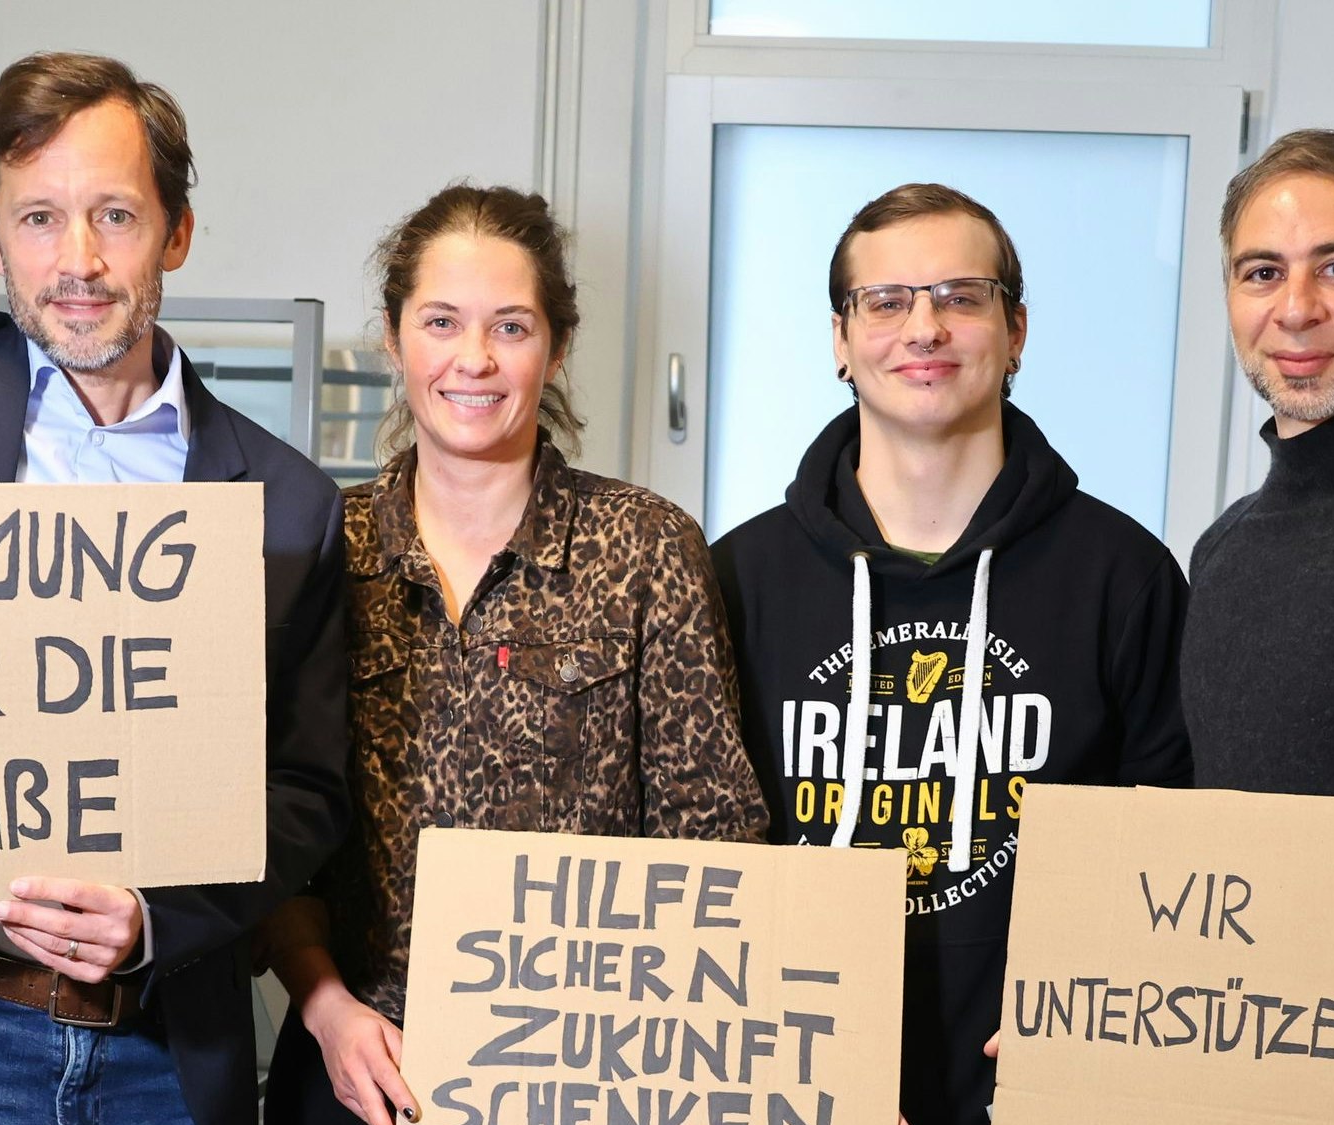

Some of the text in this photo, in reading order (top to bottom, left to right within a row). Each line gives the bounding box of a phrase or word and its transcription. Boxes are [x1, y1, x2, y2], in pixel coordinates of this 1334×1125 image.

[35, 635, 178, 713] DIE
[809, 642, 854, 685] THE
[870, 621, 970, 650] MERAL
[795, 776, 1022, 825] ORGINLS
[513, 854, 743, 930] HILFE
[905, 832, 1018, 915] OLLECTION
[1139, 871, 1255, 945] WIR
[450, 930, 748, 1006] SICHERN
[467, 1004, 835, 1084] ZUKUNFT
